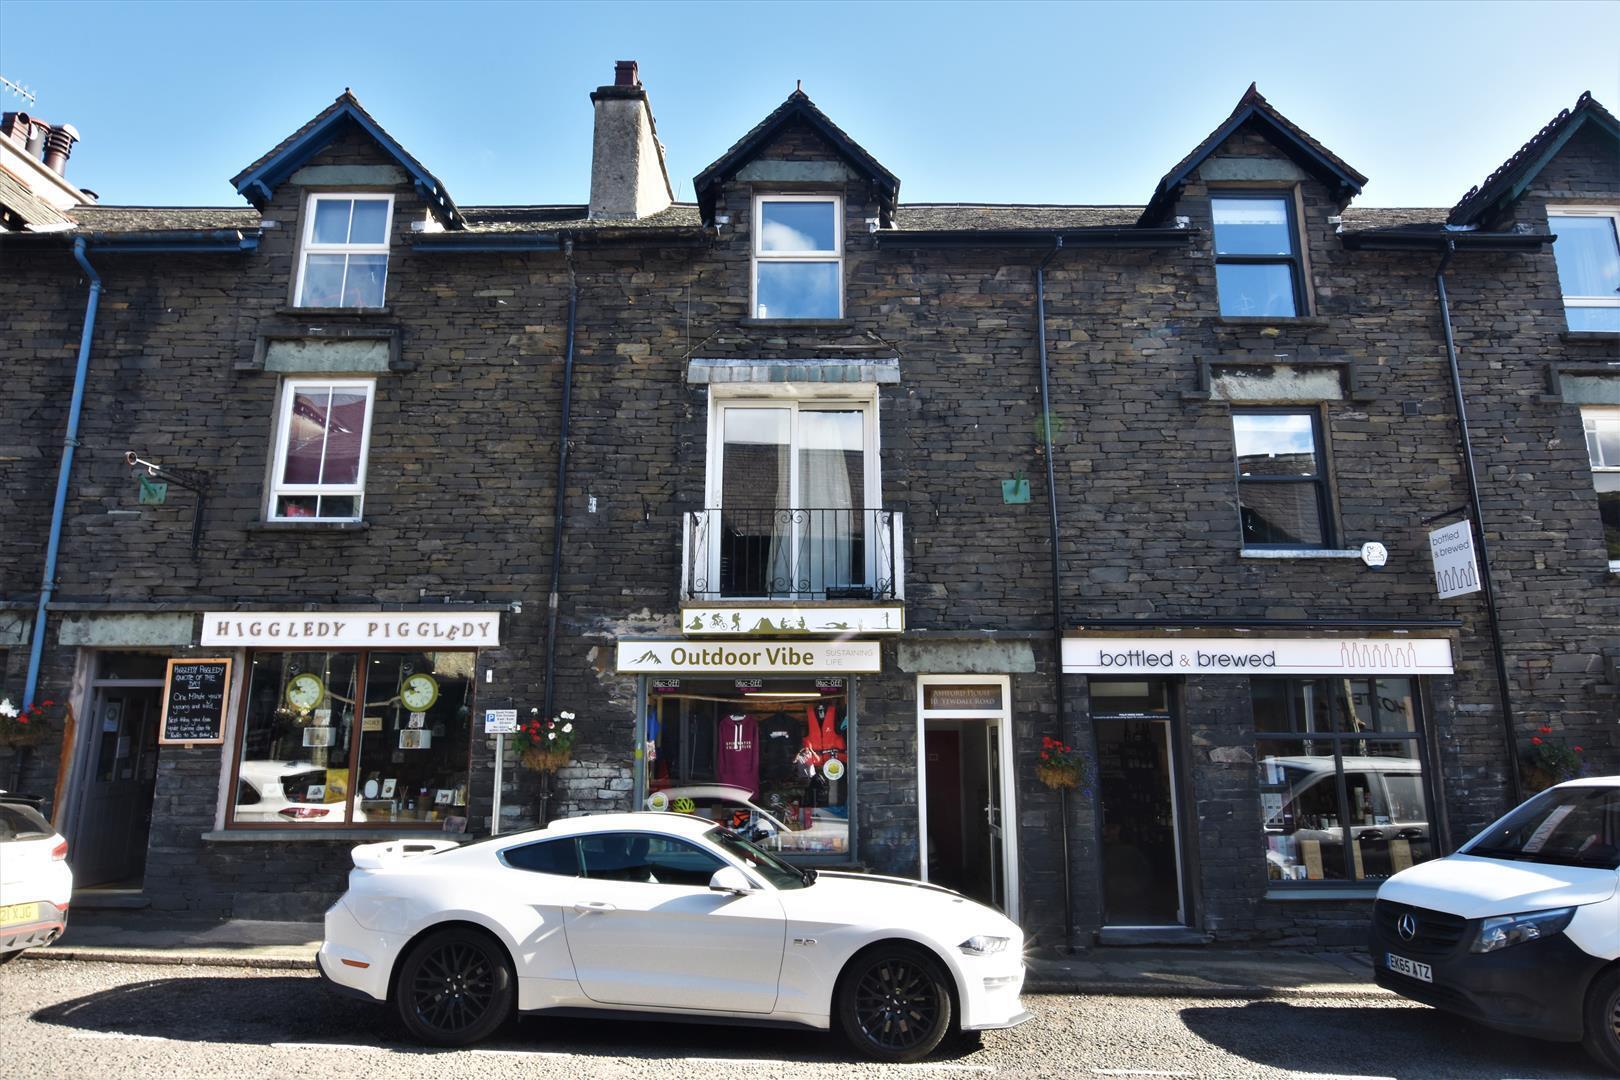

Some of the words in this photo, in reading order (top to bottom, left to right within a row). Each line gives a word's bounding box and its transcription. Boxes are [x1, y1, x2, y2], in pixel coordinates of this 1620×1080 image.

[1432, 530, 1460, 546] bottled
[1440, 541, 1470, 557] brewed
[216, 621, 346, 637] HIGGLEDY
[368, 621, 490, 640] PIGGLEDY
[670, 647, 761, 666] Outdoor
[764, 647, 814, 666] Vibe
[825, 649, 873, 657] SUSTAINING
[1100, 650, 1174, 667] bottled
[1179, 654, 1191, 667] &
[1197, 650, 1276, 667] brewed
[825, 658, 843, 666] LIFE
[173, 692, 186, 700] One
[1390, 955, 1411, 973] EK65
[1412, 962, 1431, 979] ATZ
